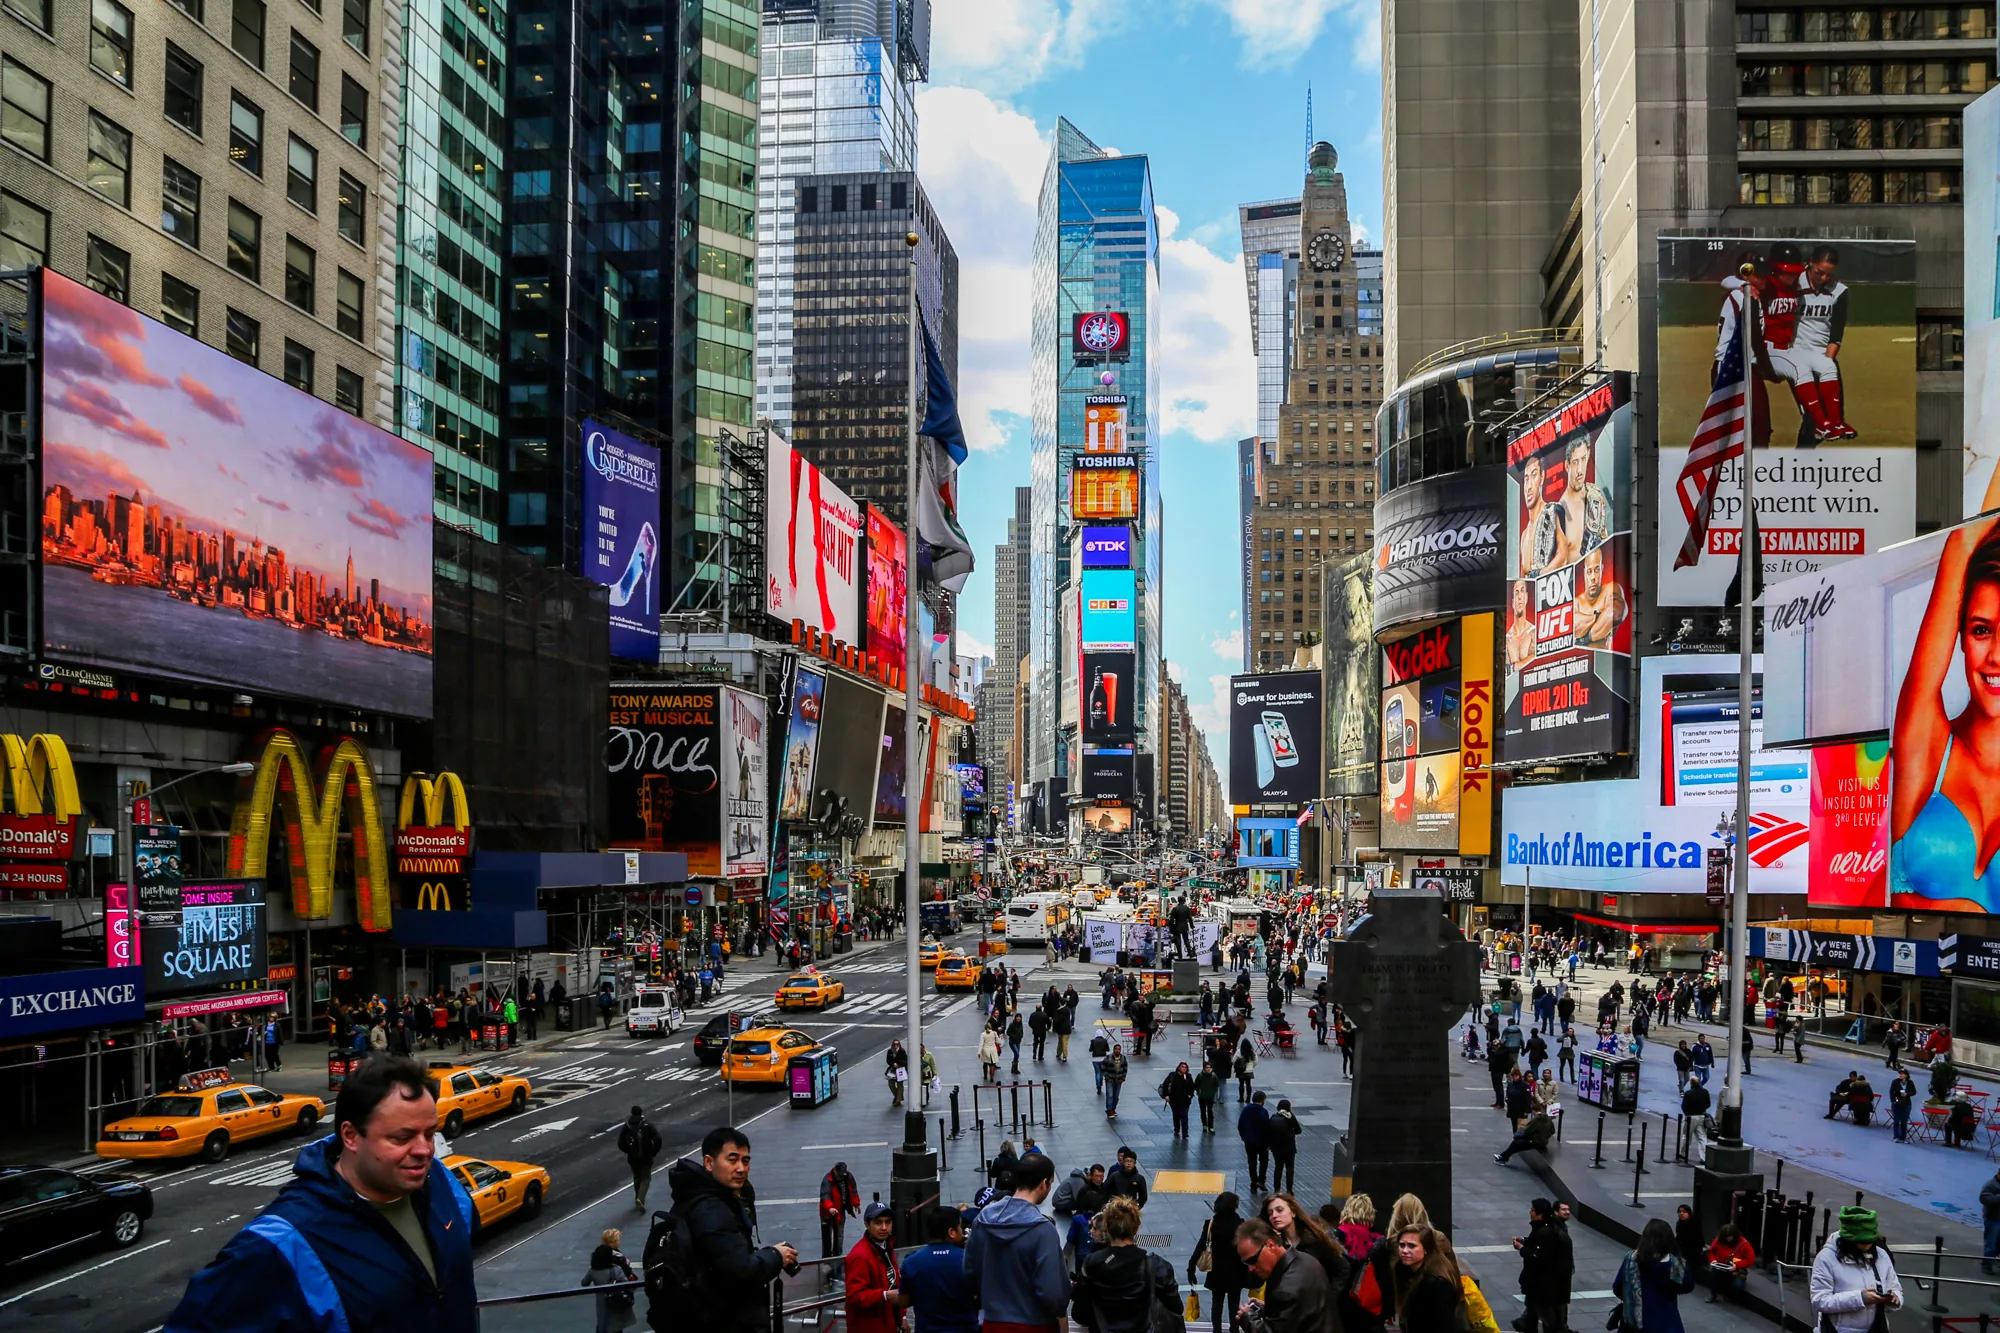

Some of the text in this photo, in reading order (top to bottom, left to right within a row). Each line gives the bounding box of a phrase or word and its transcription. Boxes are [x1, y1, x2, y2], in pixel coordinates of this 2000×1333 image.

[1707, 241, 1724, 250] 215
[1086, 396, 1127, 404] TOSHIBA
[586, 432, 658, 488] CINDERELLA
[1077, 456, 1136, 468] TOSHIBA
[1719, 457, 1883, 490] eled injured
[1710, 489, 1880, 520] pponent win.
[598, 505, 615, 520] YOU'RE
[599, 521, 618, 537] INVITED
[598, 537, 615, 552] TO THE
[1094, 541, 1126, 551] TDK
[1713, 531, 1860, 551] SPOTSMANSHIP
[598, 554, 610, 567] BALL
[838, 528, 854, 586] HIT
[1401, 546, 1498, 571] driving emotion
[1762, 559, 1793, 573] ss It
[1537, 568, 1573, 612] FOX
[1772, 577, 1838, 633] aerie
[1538, 605, 1573, 640] UFC
[1537, 636, 1574, 656] SATURDAY
[1388, 625, 1452, 685] Kodak
[610, 695, 714, 708] TONY AWARDS
[1247, 691, 1315, 702] SAFE for business.
[1522, 688, 1552, 716] APRIL
[1553, 684, 1568, 710] 20
[610, 712, 714, 725] EST MUSICAL
[1563, 709, 1579, 727] FOX
[1720, 706, 1761, 716] Tranrs
[1463, 679, 1490, 793] Kodak
[1710, 757, 1740, 765] customer
[1838, 777, 1880, 792] VISIT US
[728, 800, 764, 818] NEWSIES
[1824, 796, 1856, 810] INSIDE
[1859, 795, 1873, 809] ON
[1835, 812, 1882, 827] 3RD LEVEL
[397, 835, 465, 846] McDonald's
[1507, 832, 1701, 868] Bank of America
[1829, 841, 1886, 875] aerie
[0, 872, 63, 883] N 24 HOURS
[158, 884, 179, 899] Potter
[1448, 879, 1472, 892] Jekyll
[207, 892, 234, 903] INSIDE
[1451, 888, 1475, 900] Hyde
[182, 917, 239, 944] TIMES
[1090, 925, 1105, 934] Long
[1092, 938, 1115, 949] fashion!
[1829, 941, 1851, 950] WE'RE
[163, 944, 253, 979] SQUARE
[1828, 951, 1848, 959] OPEN
[10, 984, 136, 1017] EXCHANGE
[173, 994, 279, 1015] TIMES SQUARE MUSEUM AND VISITOR CENTER
